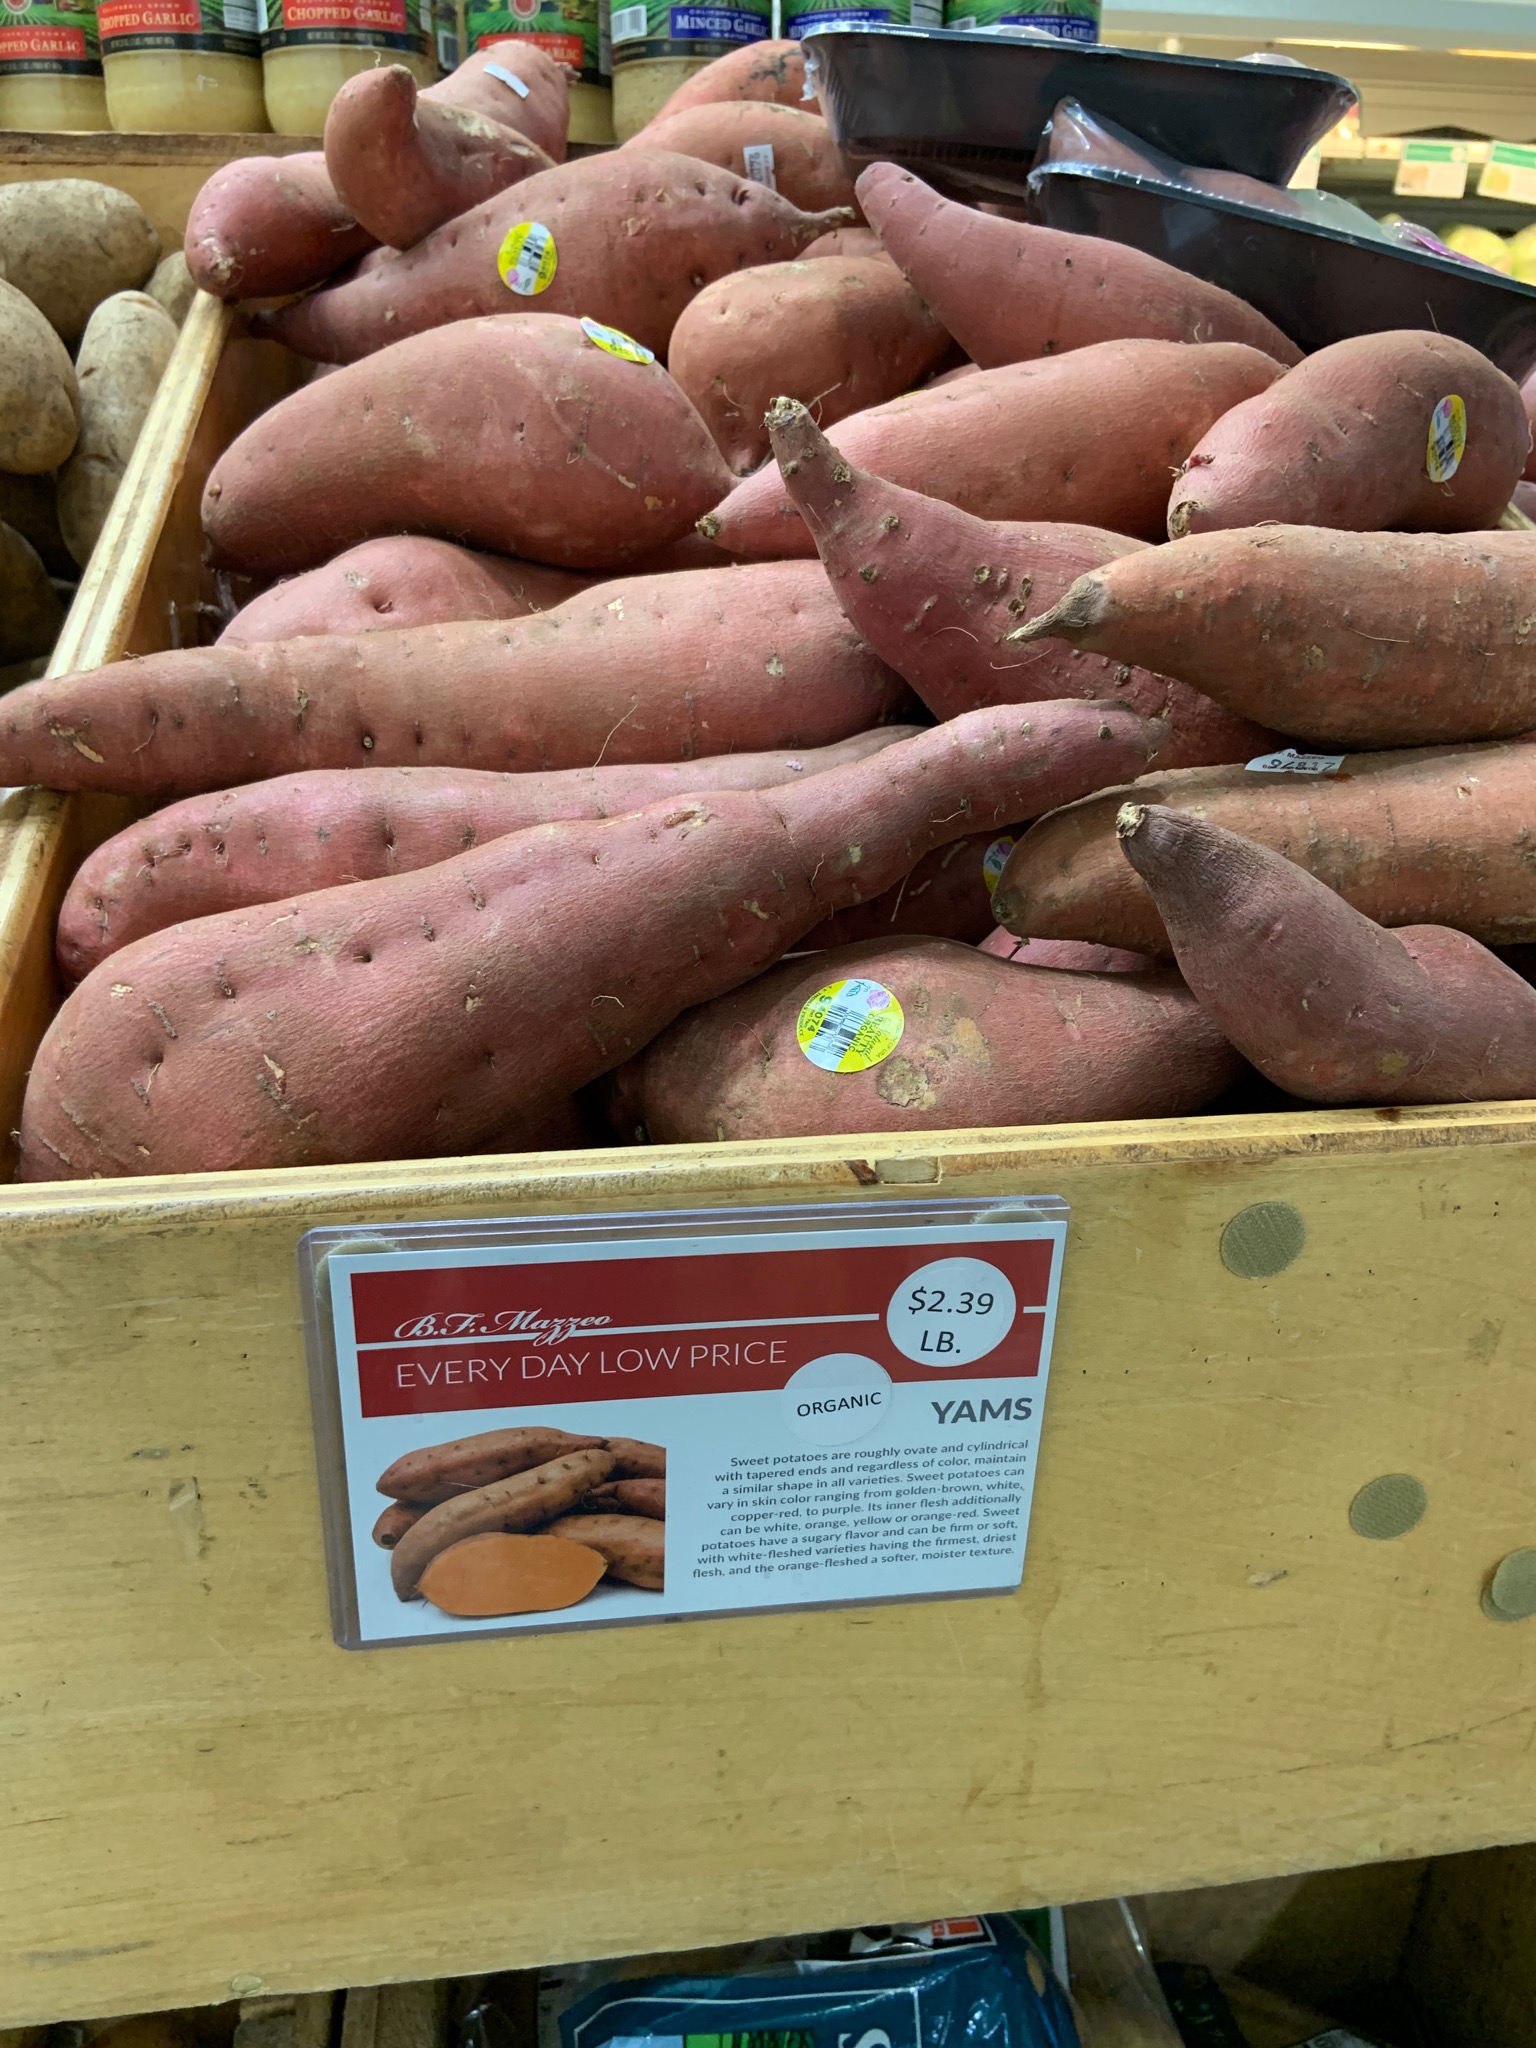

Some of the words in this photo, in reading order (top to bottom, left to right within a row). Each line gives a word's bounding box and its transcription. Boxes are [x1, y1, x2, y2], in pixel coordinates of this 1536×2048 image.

[100, 13, 140, 32] CHOPPED
[143, 11, 196, 26] GARLIC
[287, 6, 351, 21] CHOPPED
[353, 6, 404, 25] GARLIC
[675, 15, 732, 31] MINCED
[30, 38, 81, 53] GARLIC
[848, 1013, 876, 1053] ORGANIC
[855, 1013, 884, 1058] BEAUTY
[908, 1286, 994, 1315] $2.39
[479, 1307, 613, 1347] Mazzeo
[920, 1330, 962, 1354] LB.
[397, 1357, 511, 1388] EVERY
[521, 1352, 590, 1380] DAY
[601, 1346, 681, 1374] LOW
[690, 1340, 788, 1368] PRICE
[797, 1392, 882, 1417] ORGANIC
[931, 1397, 1033, 1424] YAMS
[731, 1456, 769, 1467] Sweet
[773, 1453, 828, 1466] potatoes
[831, 1451, 851, 1460] are
[854, 1447, 900, 1459] roughly
[904, 1445, 937, 1455] ovate
[941, 1443, 964, 1453] and
[967, 1440, 1028, 1452] cylindrical
[715, 1471, 742, 1482] with
[746, 1468, 795, 1480] tapered
[798, 1466, 827, 1476] ends
[831, 1464, 853, 1474] and
[857, 1459, 918, 1472] regardless
[922, 1458, 935, 1467] of
[938, 1457, 971, 1467] color,
[974, 1454, 1027, 1464] maintain
[733, 1484, 774, 1494] similar
[777, 1480, 813, 1491] shape
[816, 1480, 827, 1488] in
[831, 1478, 845, 1487] all
[848, 1476, 903, 1486] varieties.
[907, 1472, 944, 1482] Sweet
[948, 1468, 1001, 1480] potatoes
[1004, 1468, 1024, 1476] can
[707, 1501, 733, 1510] vary
[737, 1499, 748, 1507] in
[752, 1496, 777, 1507] skin
[780, 1494, 811, 1505] color
[814, 1492, 860, 1503] ranging
[864, 1489, 892, 1498] from
[895, 1485, 983, 1498] golden-brown,
[986, 1481, 1024, 1491] white,
[731, 1508, 802, 1522] copper-red,
[806, 1507, 818, 1516] to
[822, 1504, 864, 1516] purple.
[868, 1503, 882, 1511] Its
[886, 1500, 916, 1510] inner
[920, 1499, 949, 1508] flesh
[952, 1494, 1022, 1506] additionally
[720, 1527, 741, 1536] can
[746, 1524, 760, 1534] be
[764, 1522, 801, 1533] white,
[805, 1520, 849, 1530] orange,
[853, 1515, 892, 1527] yellow
[911, 1509, 979, 1522] orange-red.
[983, 1507, 1020, 1517] Sweet
[698, 1554, 725, 1564] with
[728, 1547, 812, 1562] white-fleshed
[816, 1544, 866, 1555] varieties
[870, 1540, 908, 1551] having
[912, 1538, 931, 1547] the
[935, 1536, 979, 1546] firmest,
[983, 1533, 1016, 1543] driest
[701, 1540, 756, 1552] potatoes
[759, 1537, 788, 1547] have
[802, 1533, 841, 1544] sugary
[845, 1529, 878, 1540] flavor
[882, 1527, 904, 1537] and
[908, 1526, 928, 1535] can
[932, 1524, 946, 1533] be
[950, 1523, 973, 1532] firm
[992, 1520, 1018, 1529] soft,
[693, 1567, 725, 1578] flesh,
[729, 1565, 751, 1575] and
[755, 1563, 774, 1573] the
[778, 1556, 868, 1571] orange-fleshed
[881, 1553, 918, 1562] softer,
[922, 1549, 966, 1559] moister
[970, 1547, 1014, 1557] texture.
